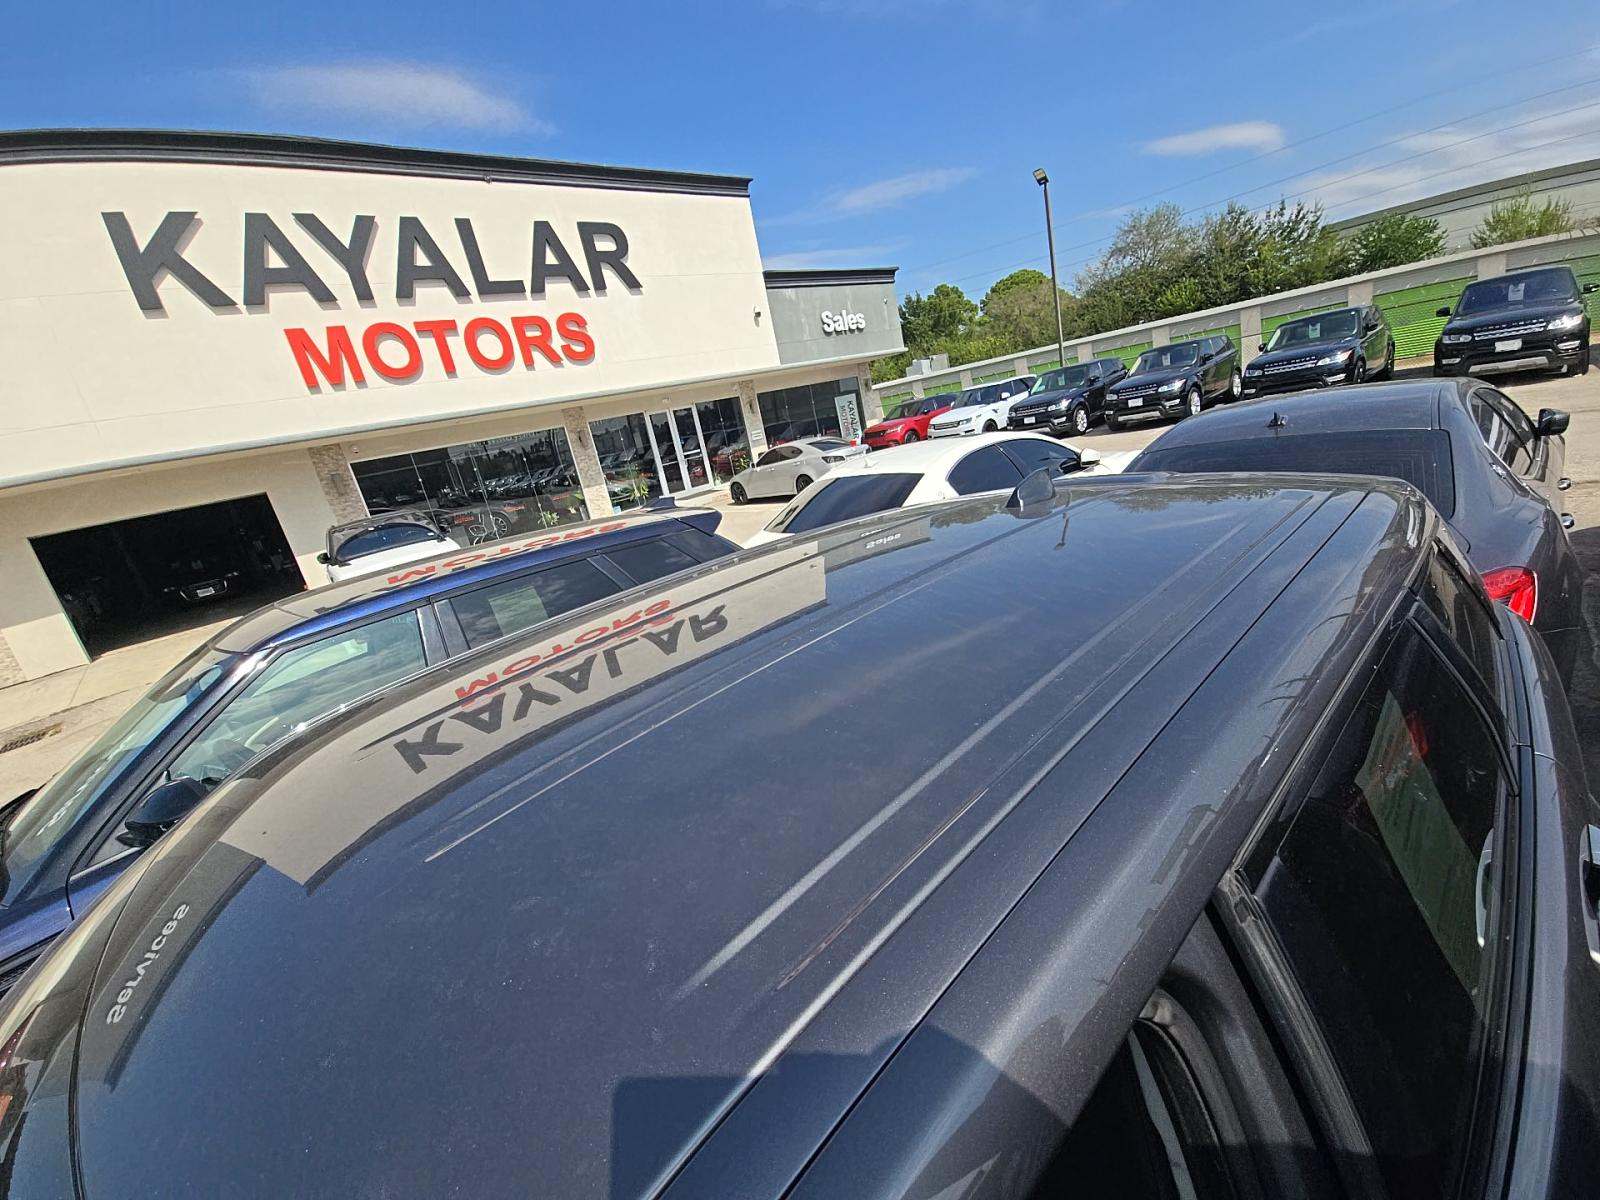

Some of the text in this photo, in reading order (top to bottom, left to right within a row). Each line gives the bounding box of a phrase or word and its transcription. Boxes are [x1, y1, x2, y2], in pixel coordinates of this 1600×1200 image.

[102, 211, 643, 312] KAYALAR
[284, 312, 596, 389] MOTORS
[821, 309, 866, 333] Sales
